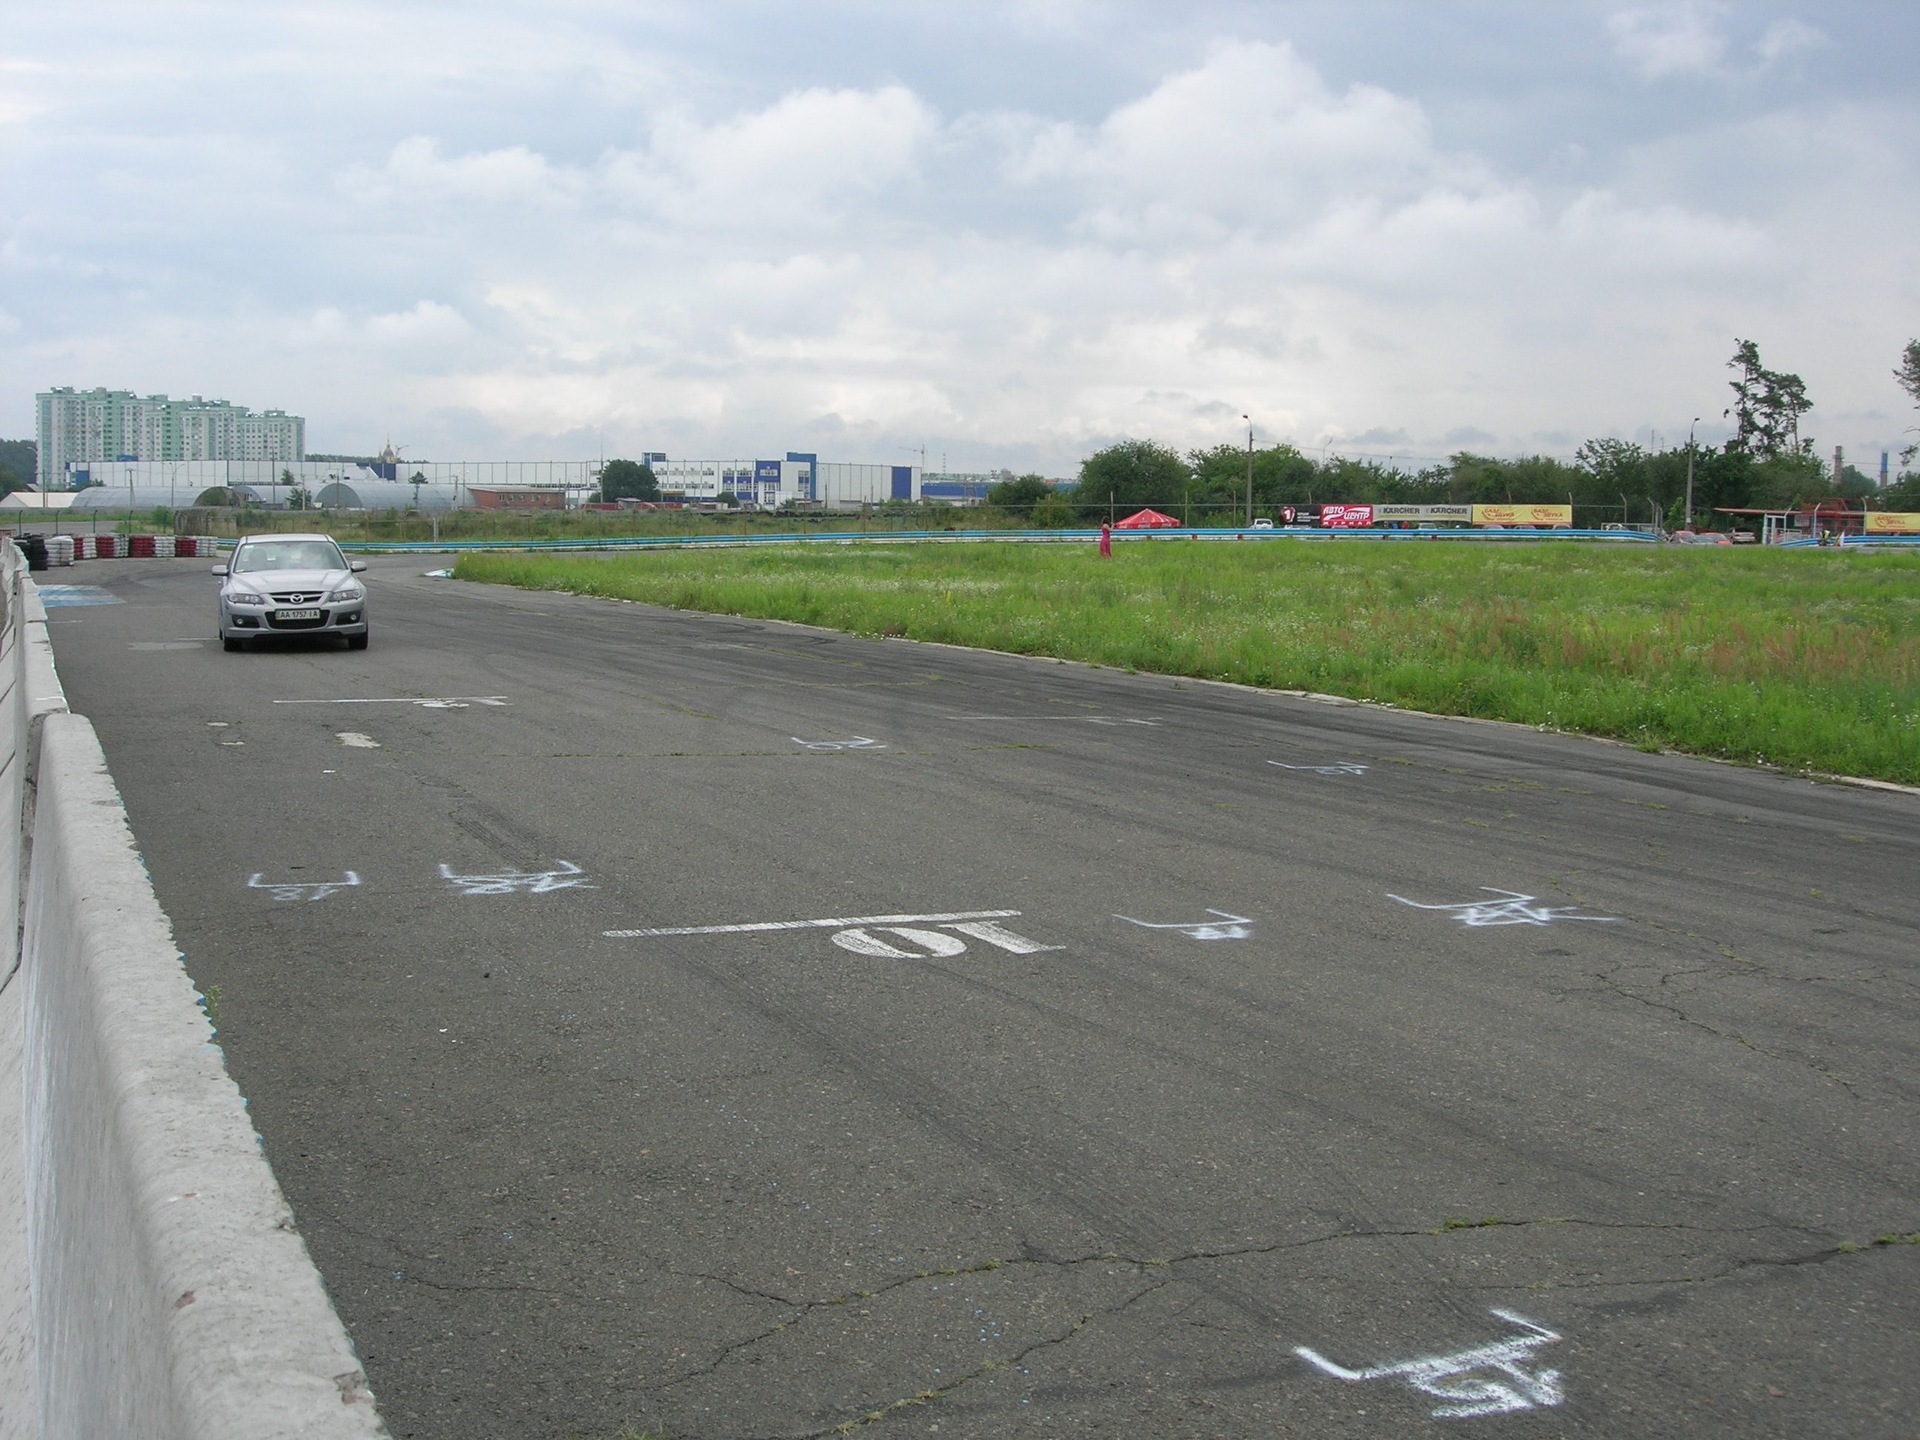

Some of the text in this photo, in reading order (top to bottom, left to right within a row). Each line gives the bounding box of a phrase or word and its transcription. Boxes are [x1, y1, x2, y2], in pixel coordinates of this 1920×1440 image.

[1284, 510, 1291, 520] 1
[1323, 506, 1345, 515] АВТО
[1343, 512, 1370, 520] ЦЕНТР
[830, 921, 1067, 959] 10
